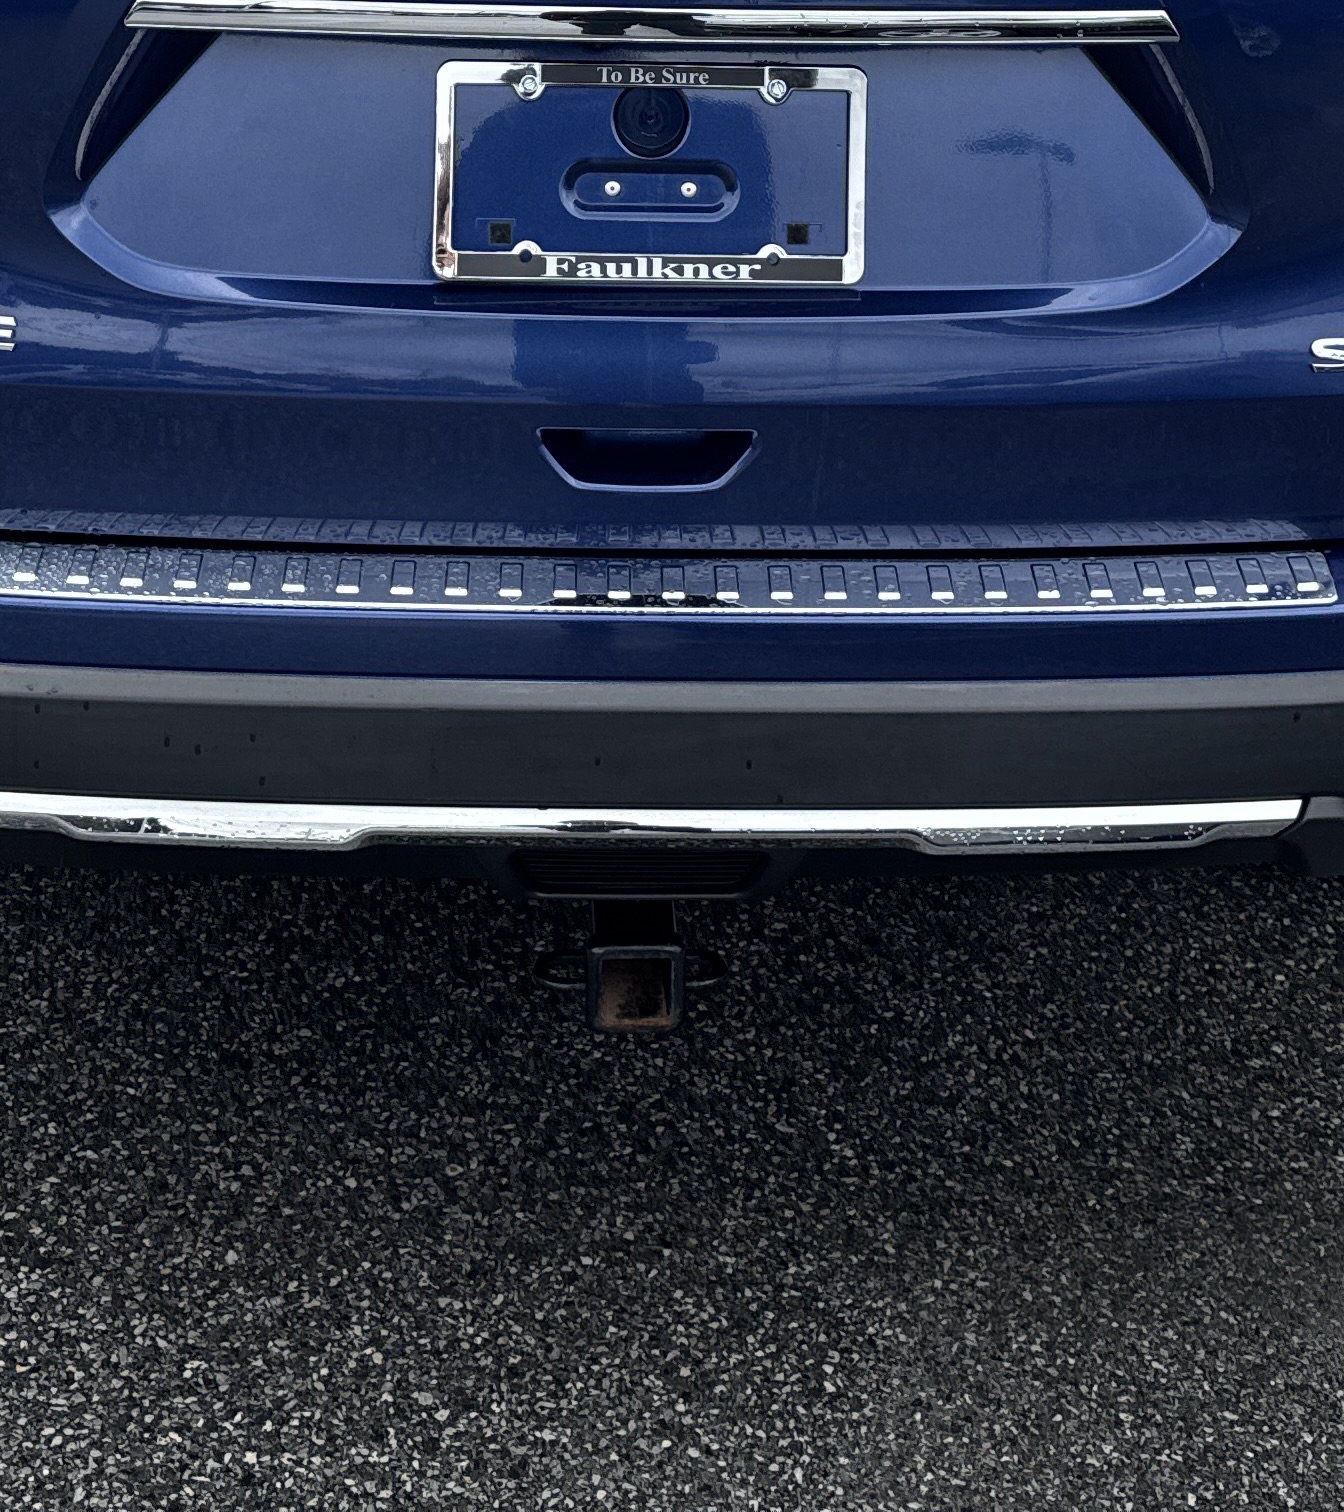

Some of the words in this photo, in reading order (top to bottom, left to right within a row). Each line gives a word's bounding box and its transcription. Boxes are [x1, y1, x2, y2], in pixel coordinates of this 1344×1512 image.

[596, 66, 623, 83] To
[629, 67, 656, 84] Be
[661, 67, 710, 85] Sure
[540, 255, 762, 280] Faulkner
